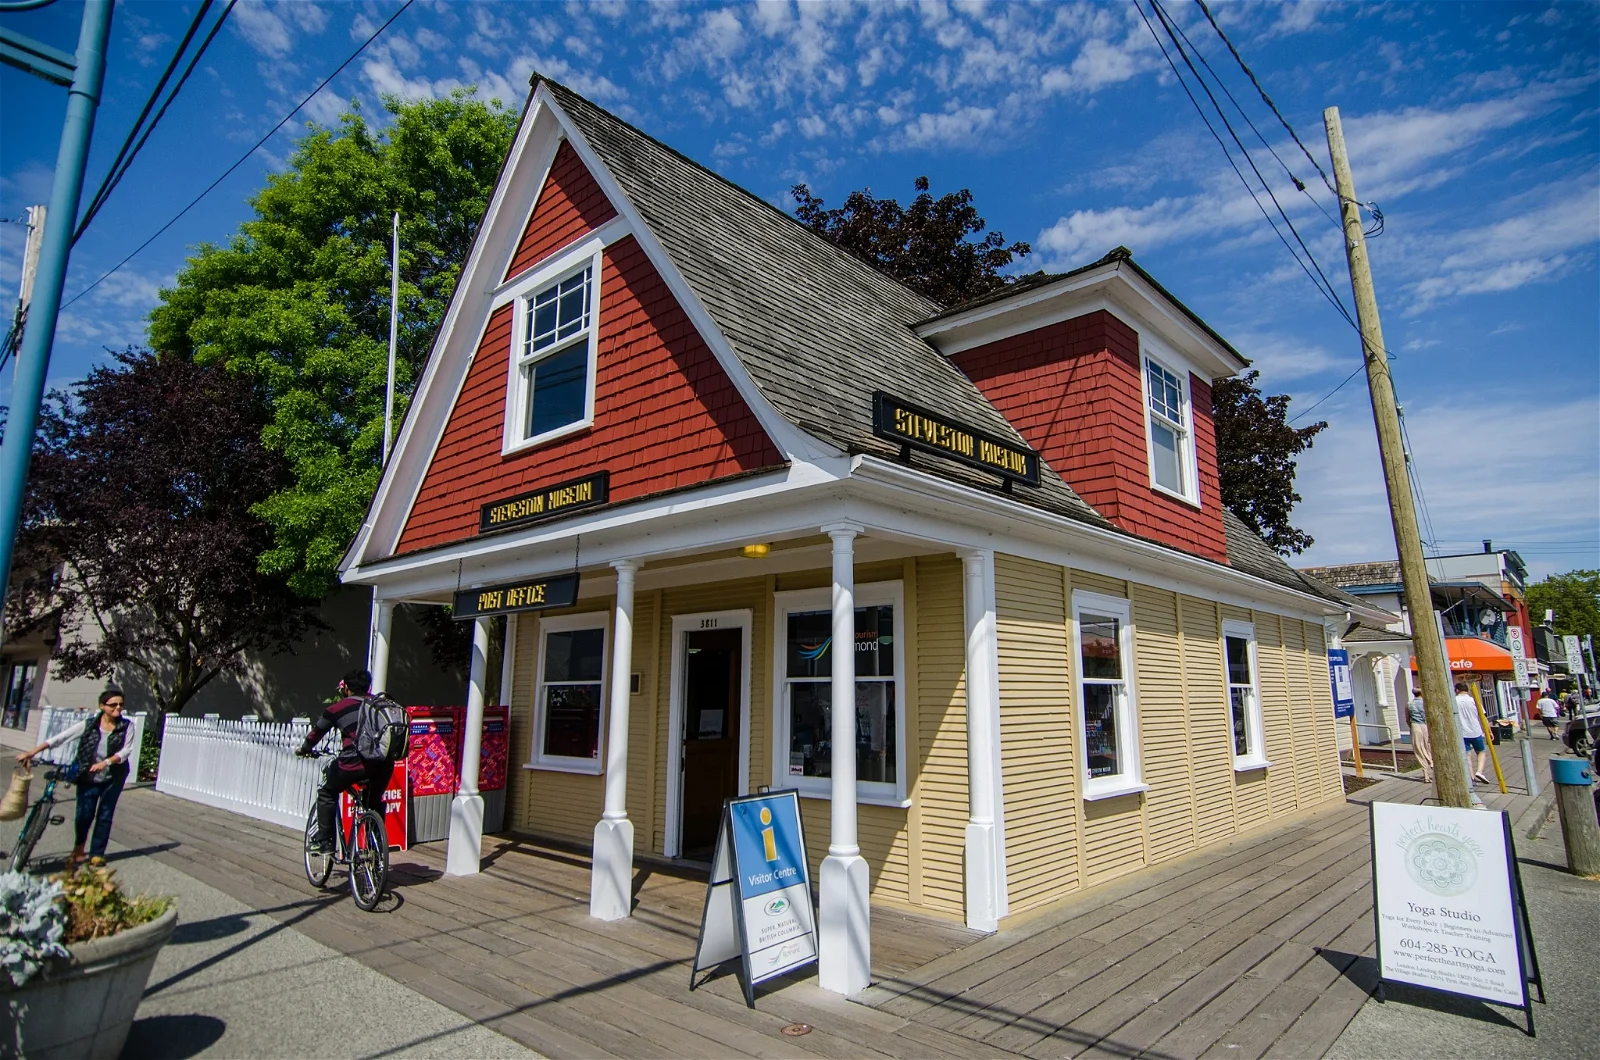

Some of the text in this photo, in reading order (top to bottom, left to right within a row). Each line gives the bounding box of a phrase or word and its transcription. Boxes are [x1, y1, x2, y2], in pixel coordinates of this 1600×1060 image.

[895, 407, 1026, 476] STEVESTON MUSEUM
[490, 481, 592, 523] STEVESTON MUSEUM
[478, 584, 546, 611] POST OFFICE
[700, 618, 718, 628] 3811
[855, 630, 878, 638] ourism
[1396, 815, 1485, 858] perfect hearts yoga
[748, 867, 796, 886] Visitor Centre
[1408, 902, 1481, 922] Yoga Studio
[778, 919, 797, 928] NATURAL
[1402, 923, 1432, 933] Workshops
[1441, 929, 1464, 937] Teacher
[1466, 933, 1491, 943] Training
[1444, 923, 1472, 932] Beginners
[1483, 929, 1513, 938] Advanced
[759, 926, 800, 944] BRITISH COLUMBIA
[1400, 938, 1496, 964] 604-285-YOGA
[1393, 950, 1506, 976] www.perfectheartsyoga.com
[1417, 966, 1437, 975] Landing
